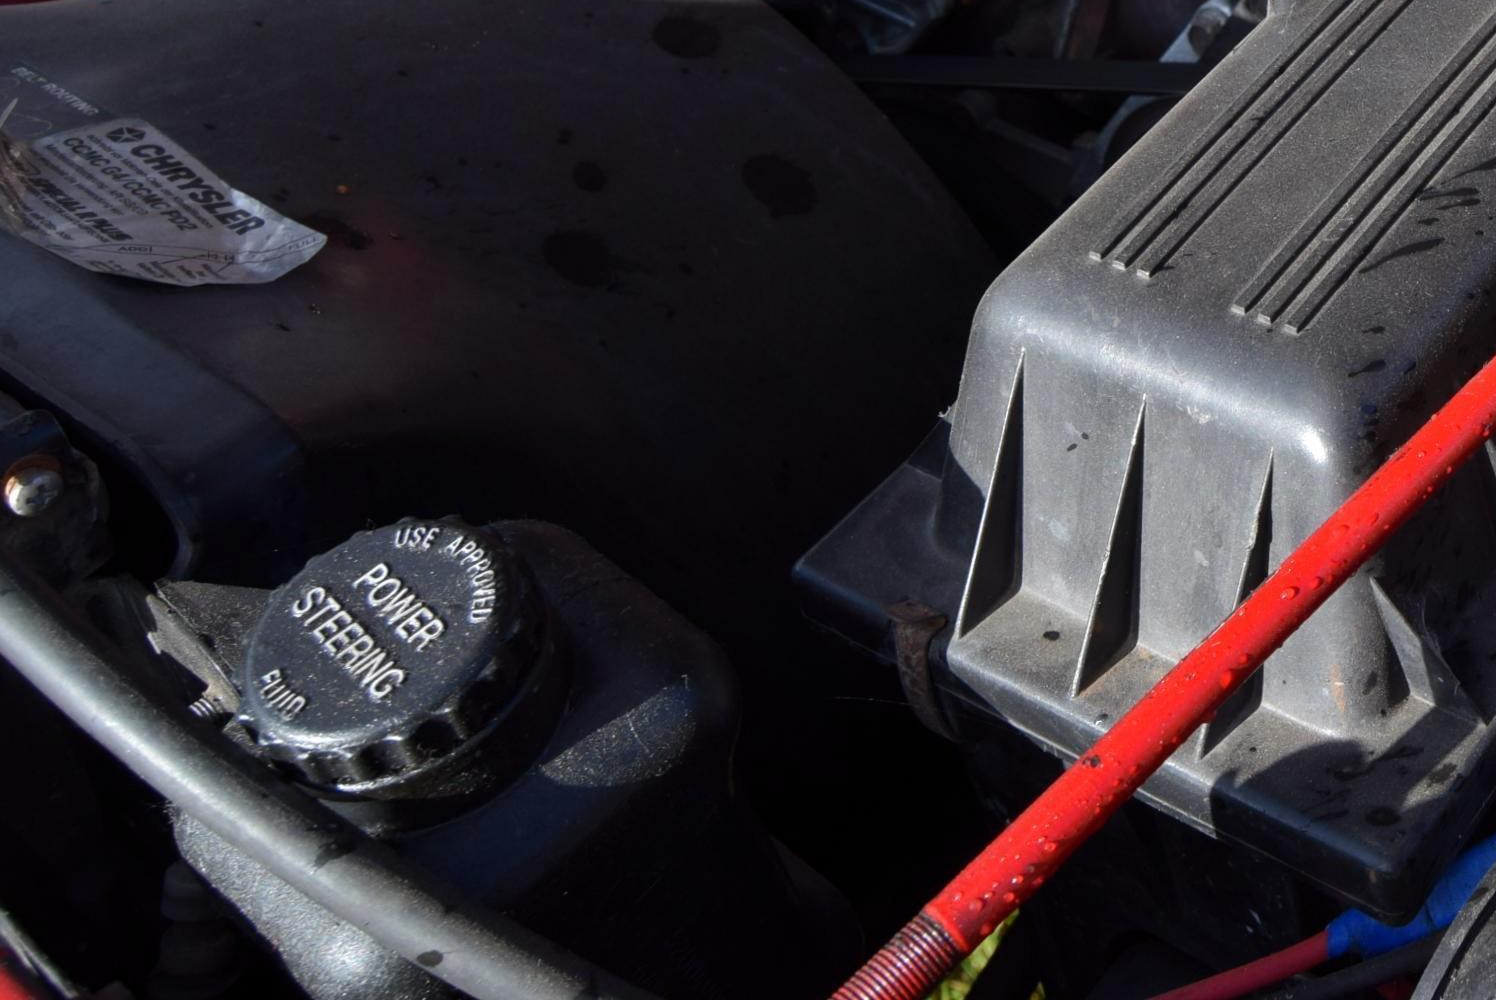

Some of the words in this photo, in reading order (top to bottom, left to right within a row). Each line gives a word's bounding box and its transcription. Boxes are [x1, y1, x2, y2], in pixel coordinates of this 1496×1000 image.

[42, 82, 99, 116] ROUTING
[64, 137, 110, 167] CCMC
[131, 144, 265, 235] CHRYSLER
[352, 563, 445, 651] POWER
[394, 526, 440, 549] USE
[446, 535, 497, 624] APPROVED
[291, 586, 406, 700] STEERING
[259, 669, 306, 721] FLUID
